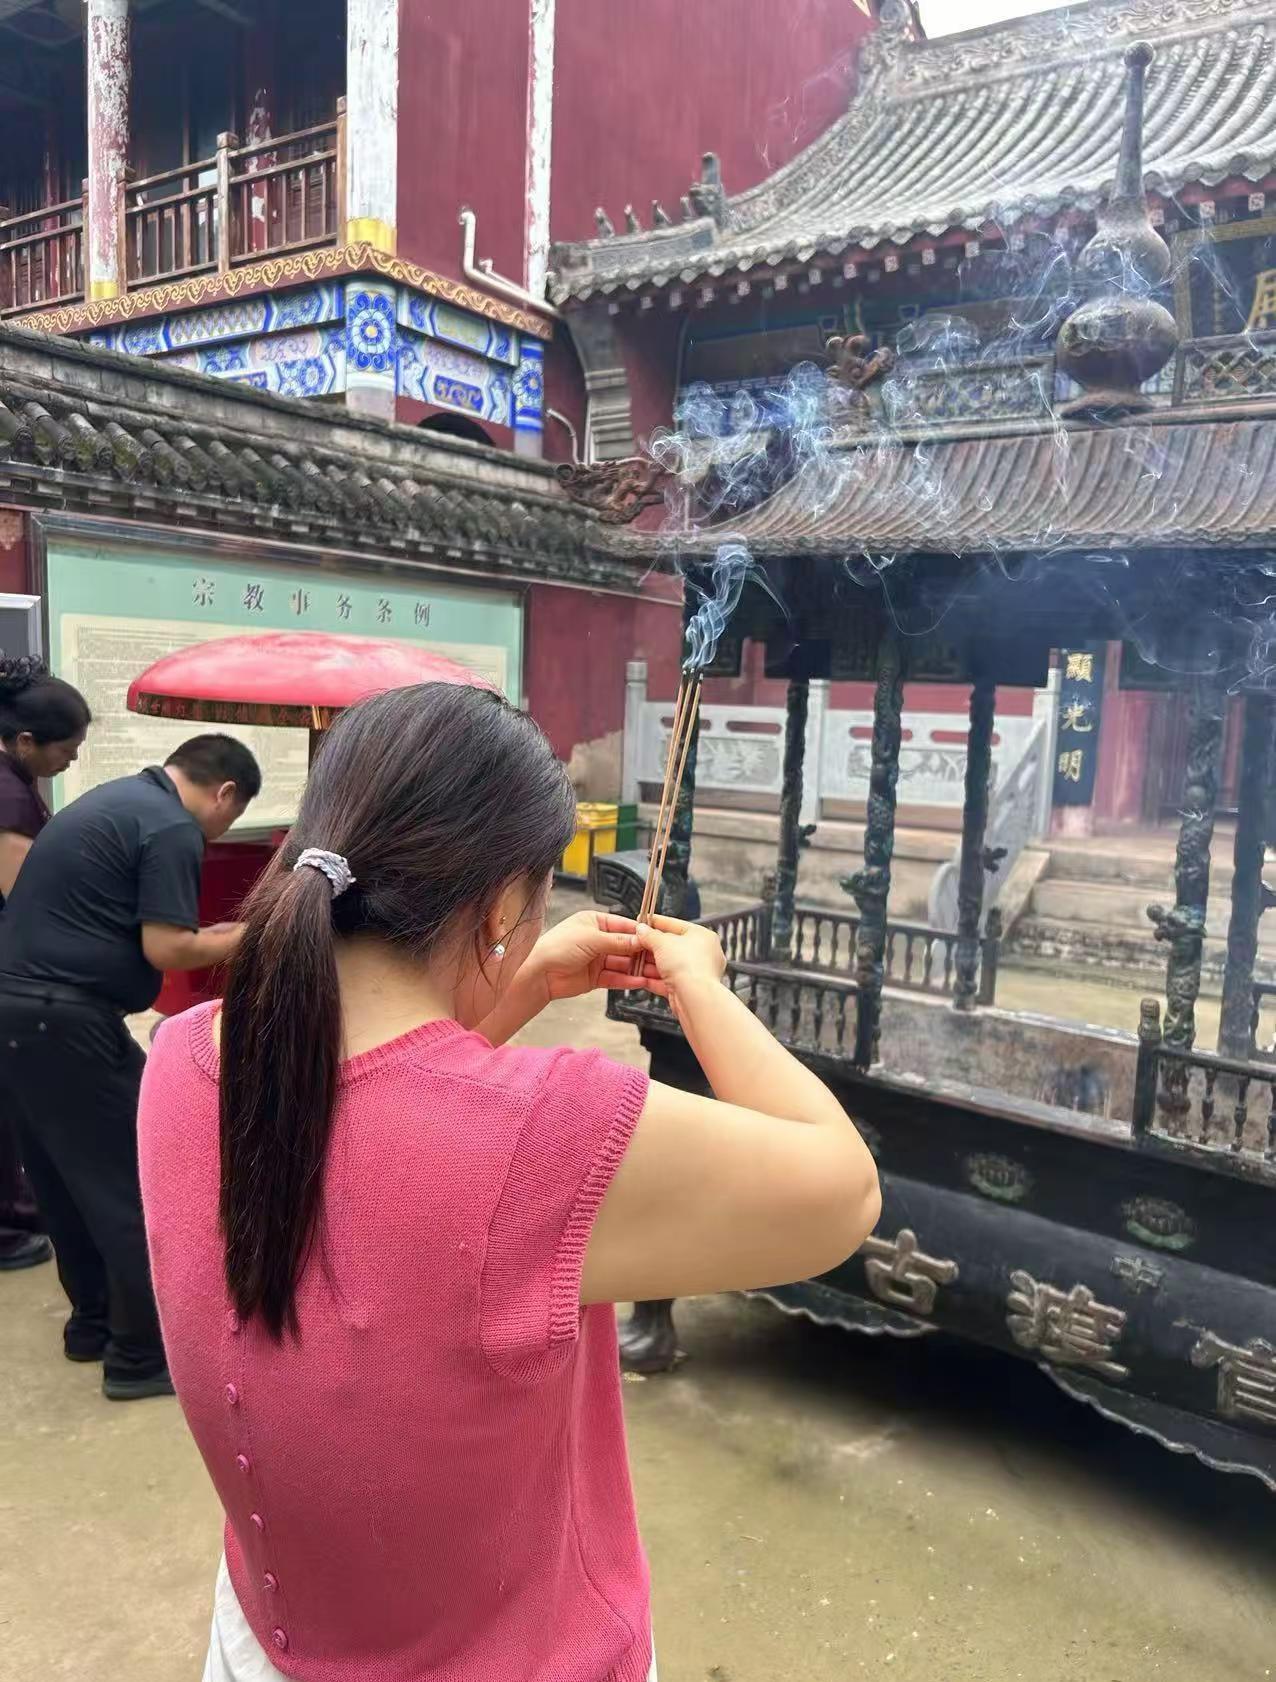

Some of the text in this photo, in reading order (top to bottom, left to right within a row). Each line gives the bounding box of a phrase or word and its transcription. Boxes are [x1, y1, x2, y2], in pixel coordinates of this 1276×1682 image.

[193, 578, 431, 627] 宗教事务条例
